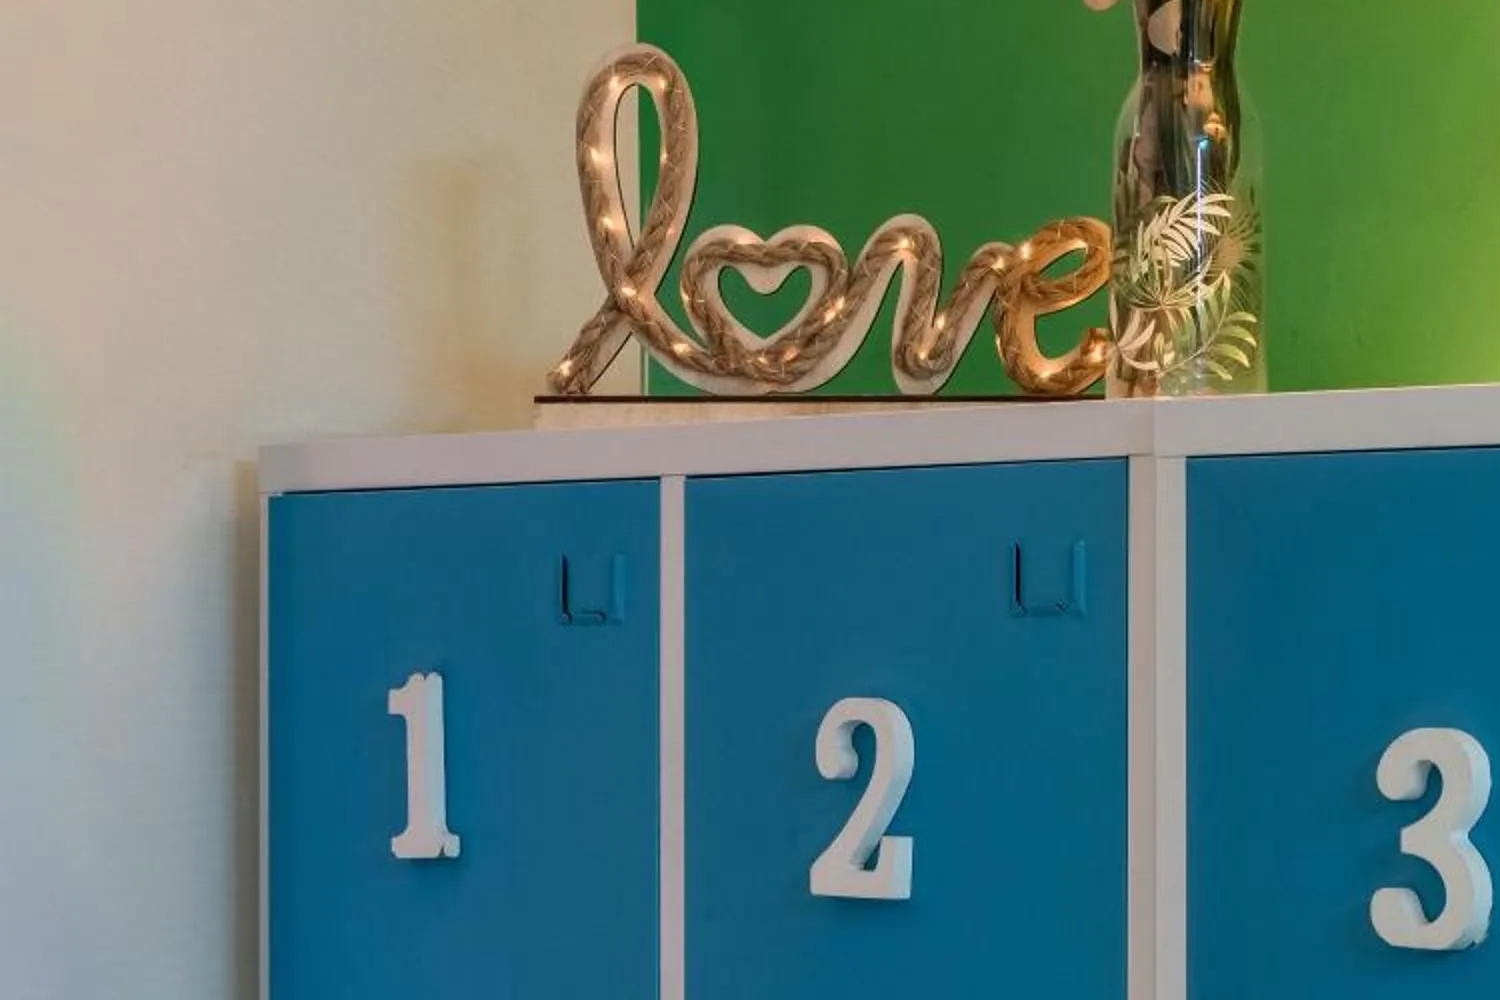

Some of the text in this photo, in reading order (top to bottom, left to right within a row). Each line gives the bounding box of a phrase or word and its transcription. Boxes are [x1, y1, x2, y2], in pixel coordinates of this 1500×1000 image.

[547, 43, 1112, 396] love
[388, 673, 460, 860] 1
[809, 697, 915, 899] 2
[1370, 727, 1493, 950] 3
